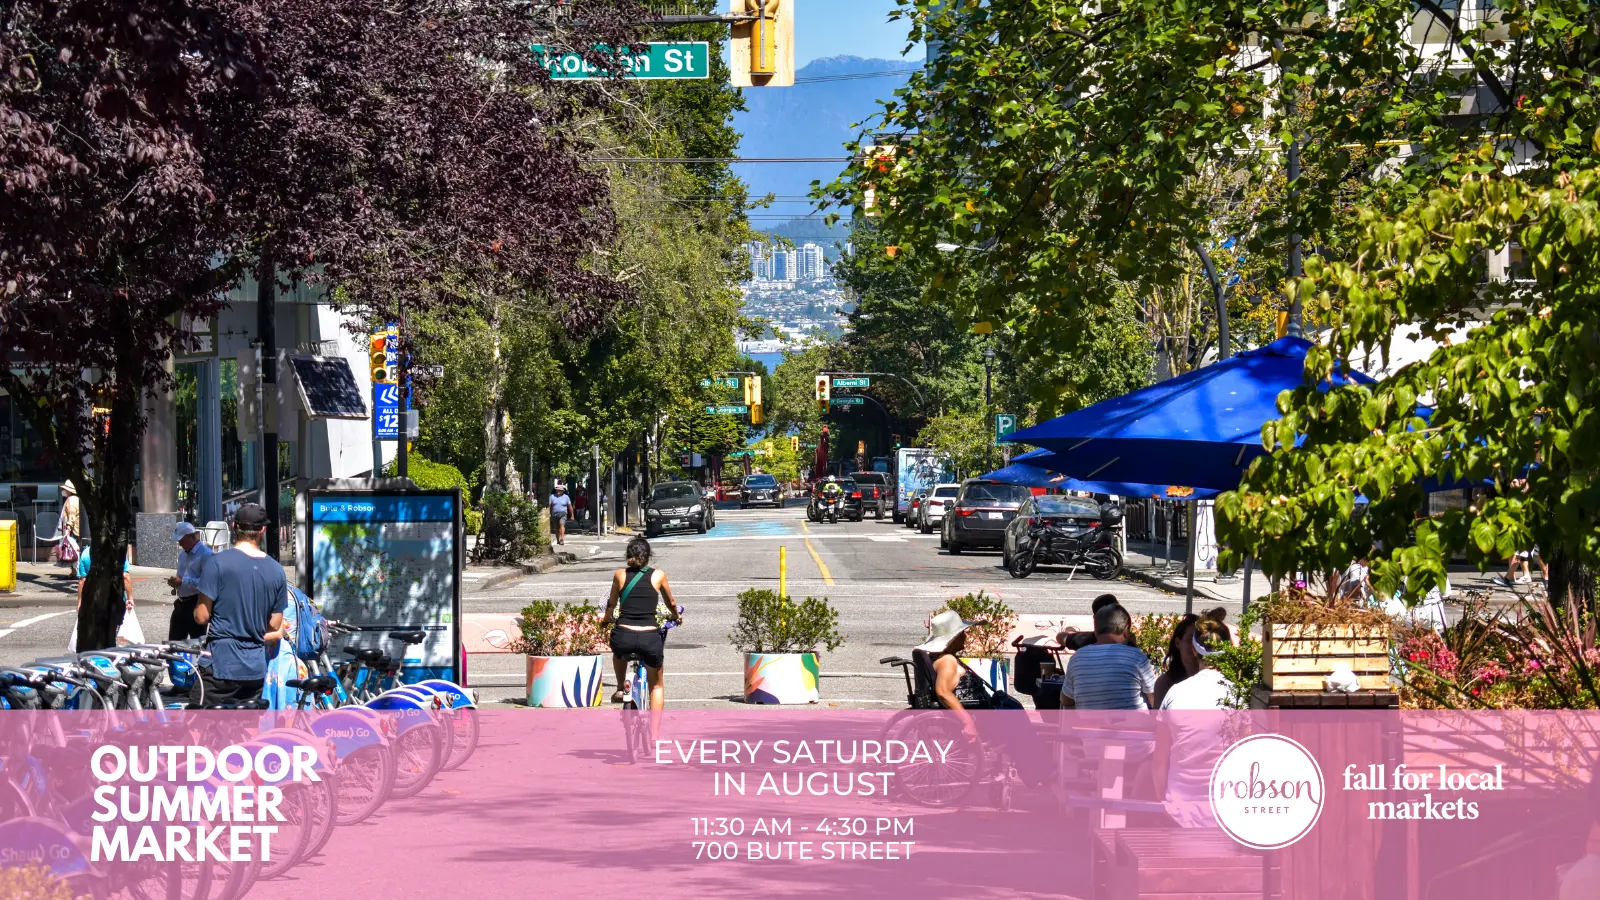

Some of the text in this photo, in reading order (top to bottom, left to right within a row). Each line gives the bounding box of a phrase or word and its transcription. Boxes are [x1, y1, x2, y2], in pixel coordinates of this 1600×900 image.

[544, 49, 694, 73] Robon St
[999, 416, 1012, 433] P
[320, 504, 338, 512] Bute
[347, 504, 376, 512] Robson
[407, 707, 420, 717] Go
[356, 727, 370, 737] Go
[49, 843, 70, 859] Go
